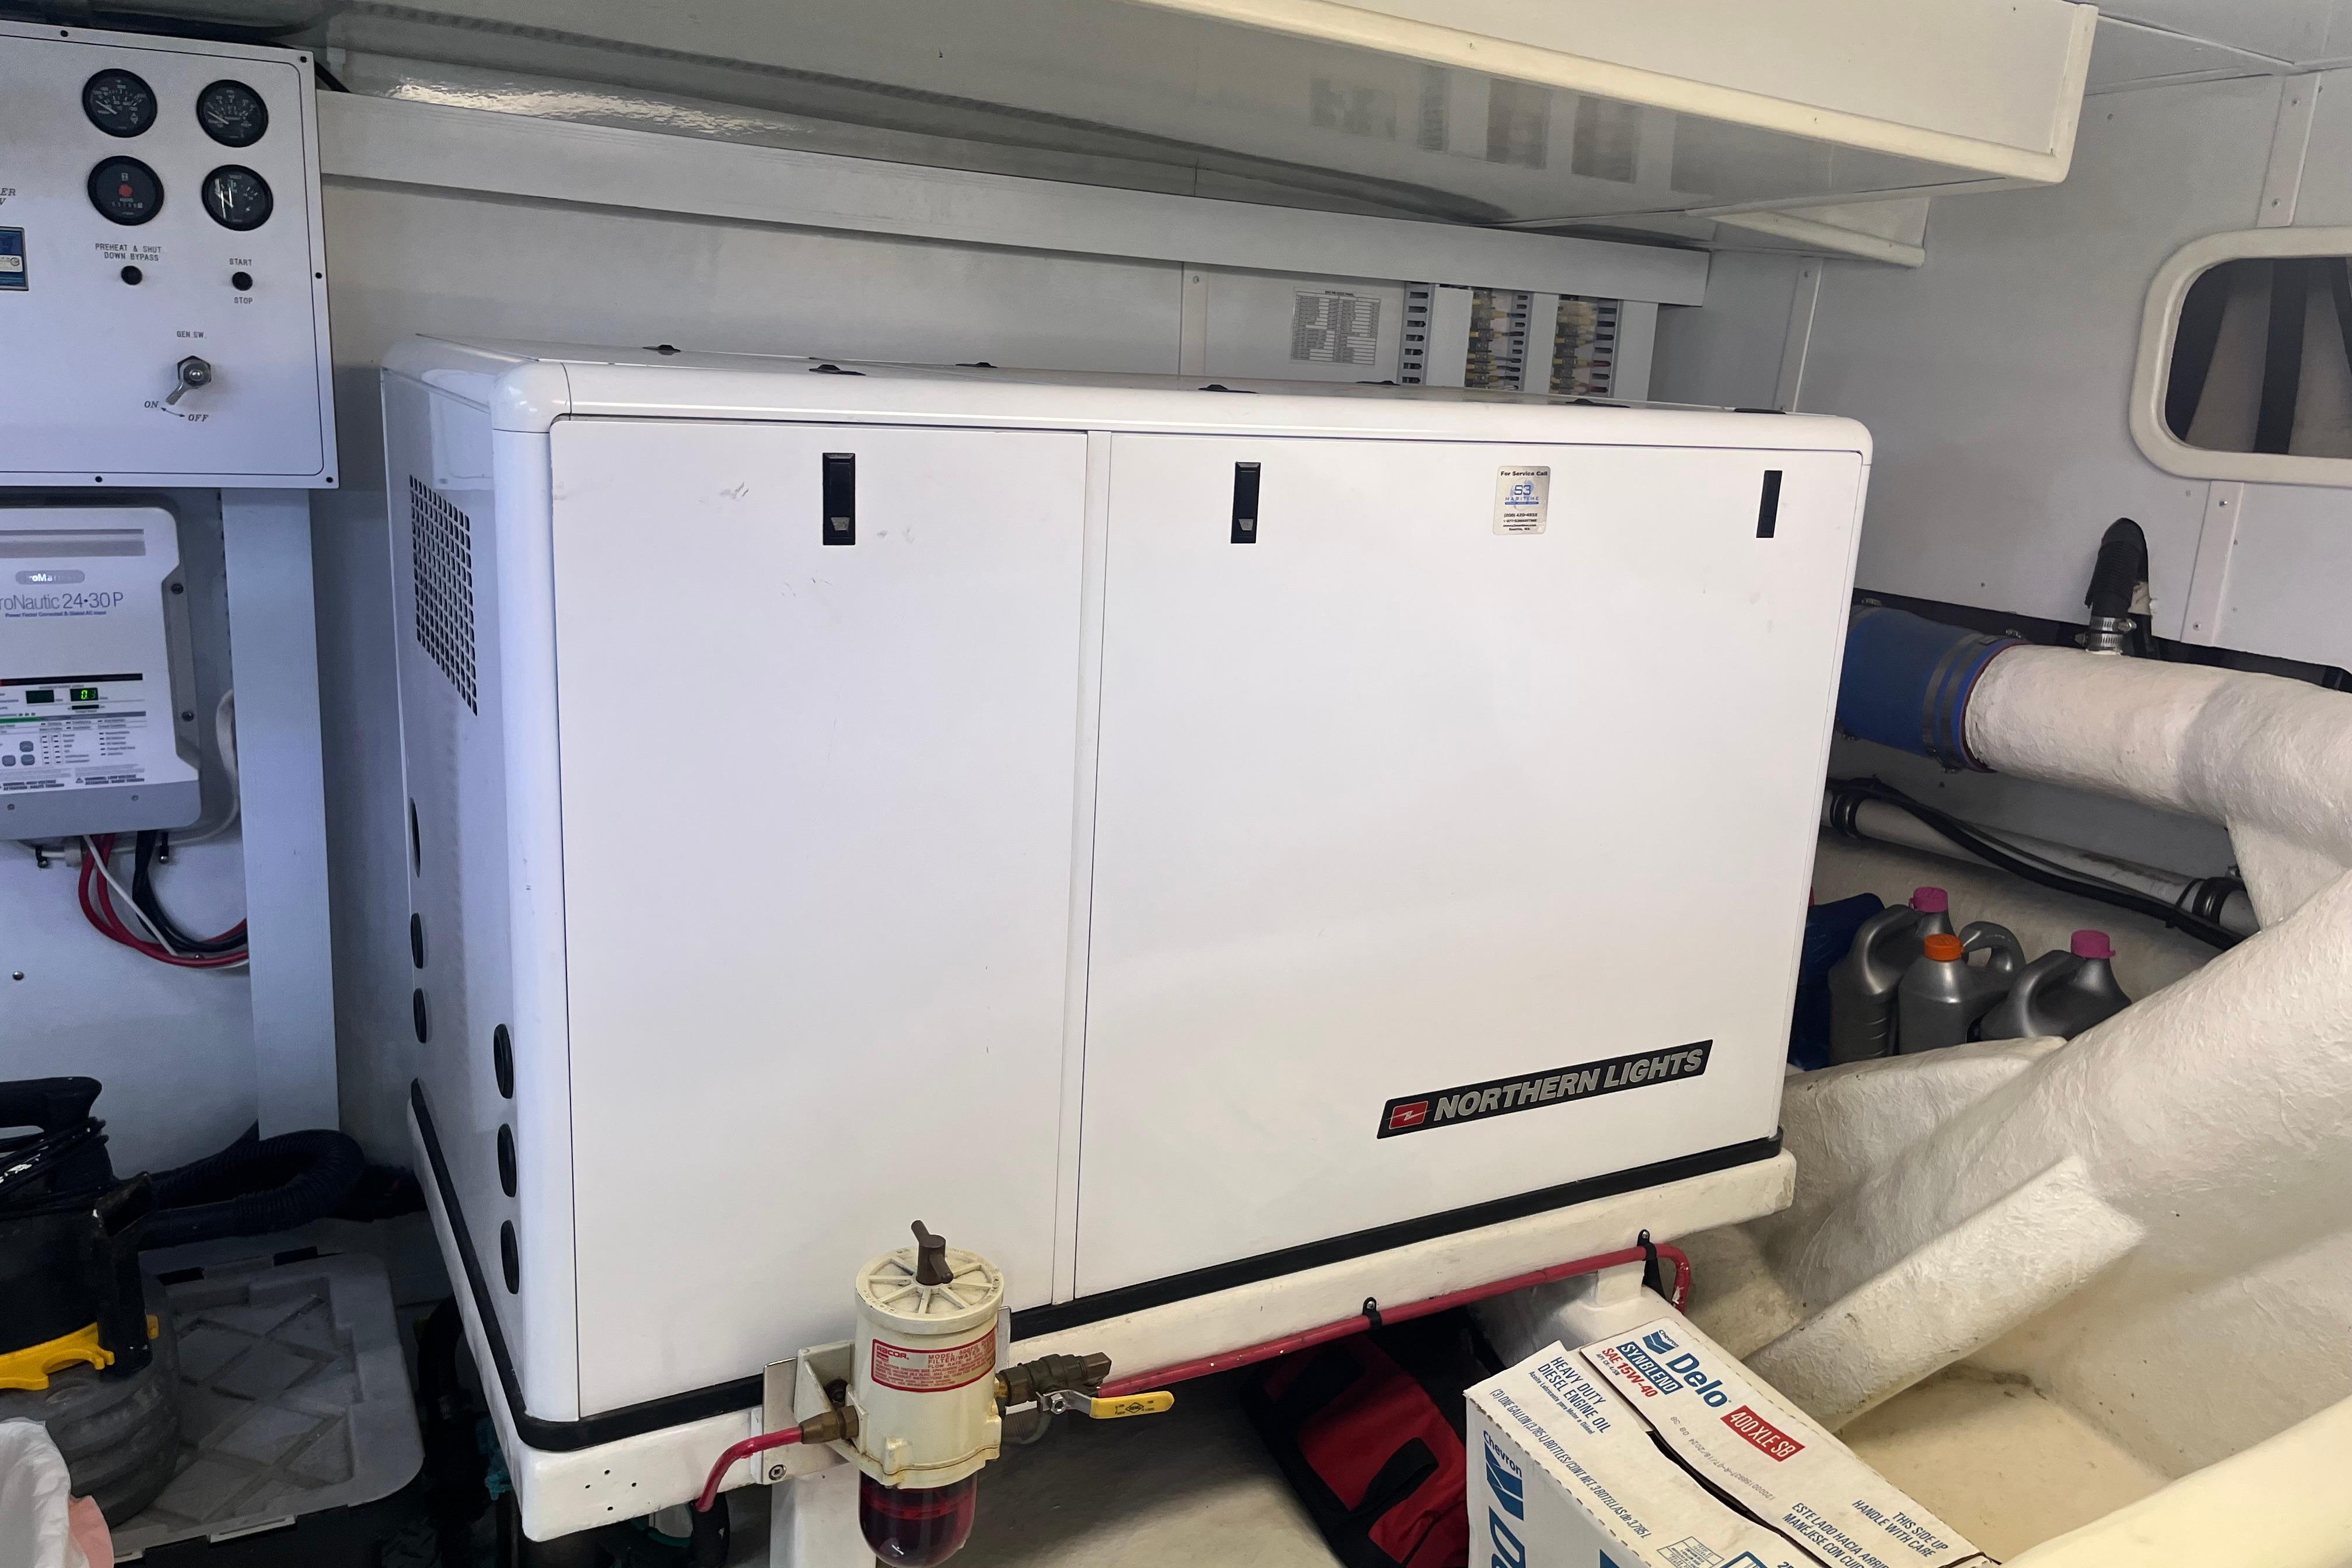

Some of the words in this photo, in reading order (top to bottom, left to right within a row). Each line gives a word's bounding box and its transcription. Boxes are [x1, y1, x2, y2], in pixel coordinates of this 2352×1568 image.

[0, 187, 16, 197] ER
[95, 243, 128, 251] PREHEAT
[104, 251, 126, 260] DOWN
[130, 253, 159, 261] BYPASS
[229, 258, 252, 266] START
[234, 296, 253, 304] STOP
[188, 414, 209, 422] OFF
[0, 593, 60, 611] roNautic
[113, 592, 124, 607] P
[1434, 1068, 1601, 1122] NORTHERN
[1603, 1049, 1704, 1088] LIGHTS
[1658, 1329, 1679, 1348] Chevron
[1550, 1356, 1584, 1384] HEAVY
[1576, 1382, 1606, 1405] DUTY
[1601, 1348, 1623, 1364] SAE
[1616, 1362, 1658, 1398] 15W-40
[1620, 1343, 1679, 1392] SYNBLEND
[1665, 1352, 1728, 1408] Delo
[1537, 1363, 1569, 1392] DIESEL
[1563, 1389, 1599, 1419] ENGINE
[1592, 1417, 1611, 1434] OIL
[1483, 1430, 1523, 1479] Chevron
[1489, 1388, 1504, 1402] (3)
[1497, 1395, 1513, 1409] ONE
[1507, 1405, 1531, 1424] GALLON
[1594, 1489, 1627, 1516] BOTELLAS
[1621, 1514, 1632, 1524] de
[1729, 1412, 1759, 1433] 400
[1748, 1426, 1781, 1448] XLE
[1770, 1441, 1797, 1458] SB
[1782, 1513, 1829, 1546] MANÉJESE
[1822, 1542, 1846, 1559] CON
[1791, 1502, 1817, 1521] ESTE
[1811, 1517, 1839, 1535] LADO
[1832, 1532, 1863, 1555] HACIA
[1852, 1500, 1891, 1527] HANDLE
[1885, 1522, 1913, 1544] WITH
[1907, 1540, 1937, 1558] CARE
[1892, 1511, 1917, 1530] THIS
[1912, 1526, 1936, 1544] SIDE
[1931, 1539, 1949, 1550] UP
